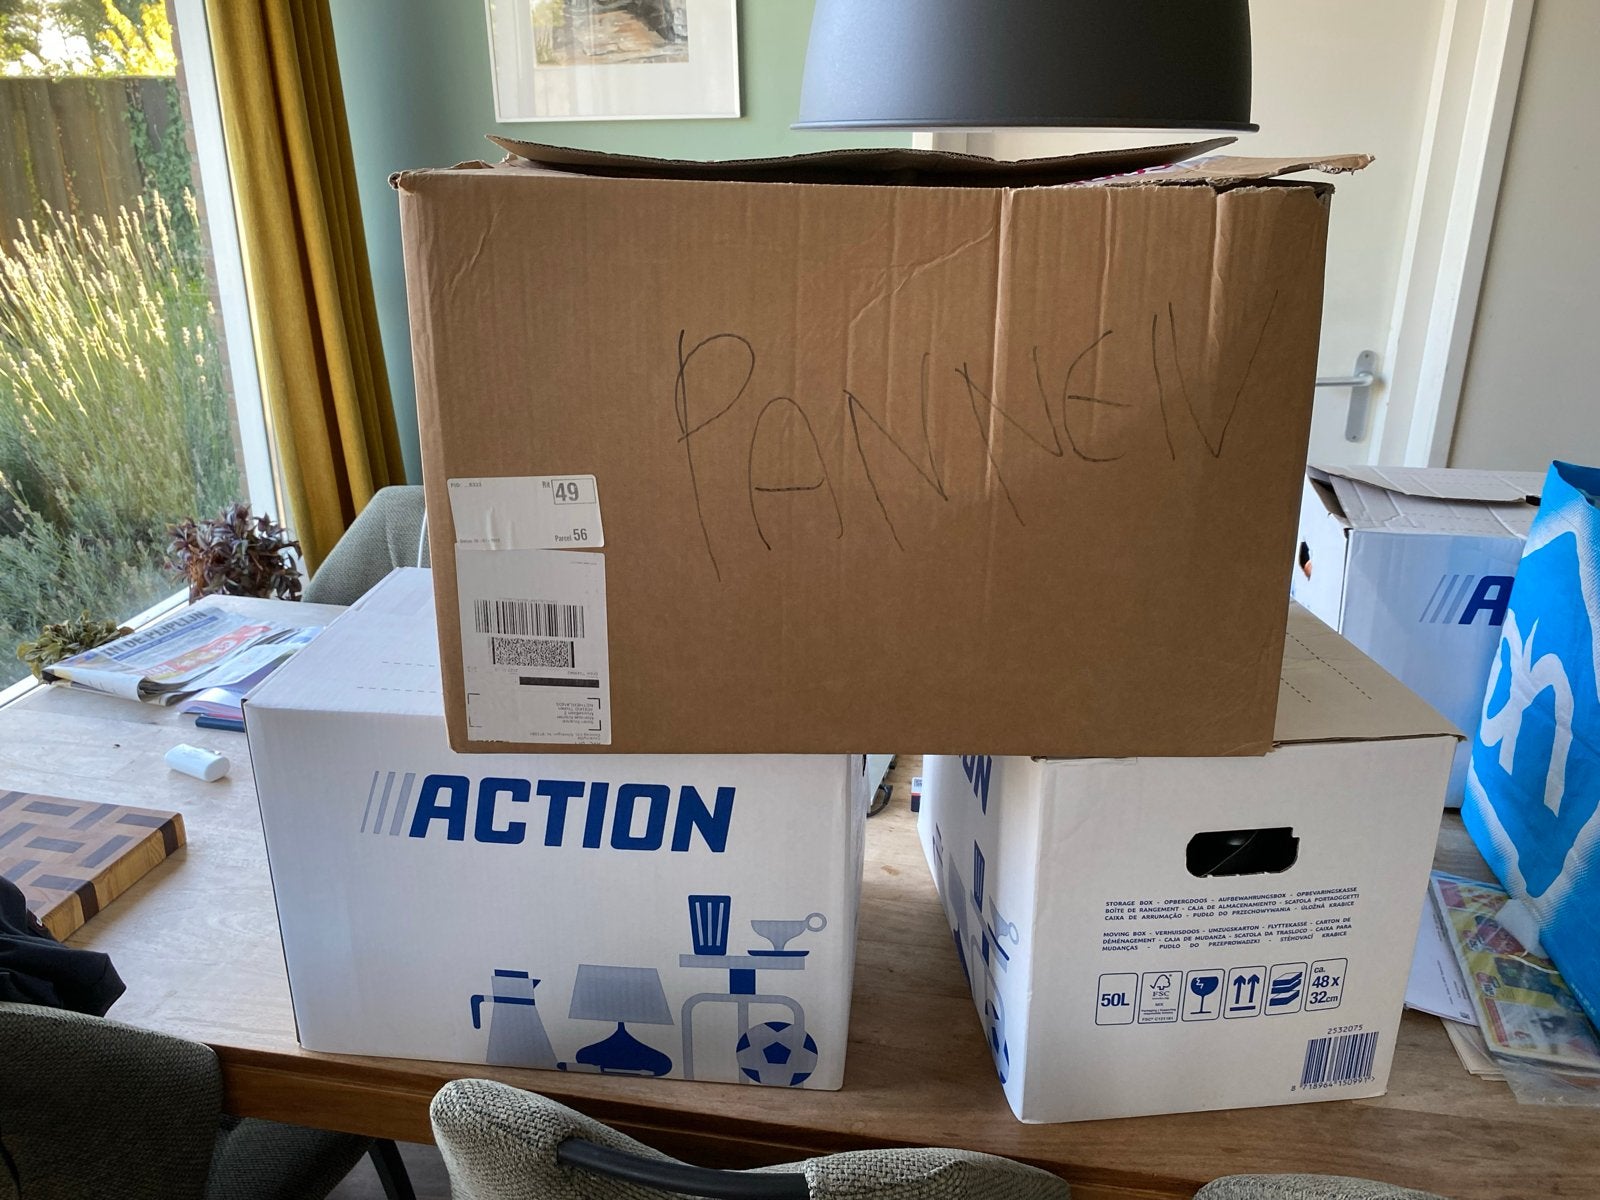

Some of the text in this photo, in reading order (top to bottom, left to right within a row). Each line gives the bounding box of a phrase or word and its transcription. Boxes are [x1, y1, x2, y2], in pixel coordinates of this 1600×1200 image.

[675, 287, 1278, 583] PANNEN
[555, 482, 579, 502] 49
[554, 528, 588, 542] Parcel 56
[101, 645, 123, 657] IN
[124, 638, 147, 649] DE
[408, 773, 736, 853] ACTION
[1218, 892, 1286, 902] AUFBEWAHRUNGSBOX
[1297, 887, 1357, 896] OPBEVARINGSKASSE
[1218, 901, 1276, 909] ALMACENAMIENTO
[1232, 907, 1290, 915] PRZECHOWYWANIA
[1208, 925, 1259, 933] UMZUGSKARTON
[1268, 921, 1307, 929] FLYTTEKASSE
[1208, 939, 1260, 947] PRZEPROWADZKI
[1312, 975, 1330, 988] 48
[1100, 992, 1130, 1008] 50L
[1309, 991, 1338, 1005] 32cm
[1327, 1024, 1363, 1035] 2532075
[1302, 1082, 1333, 1090] 718964
